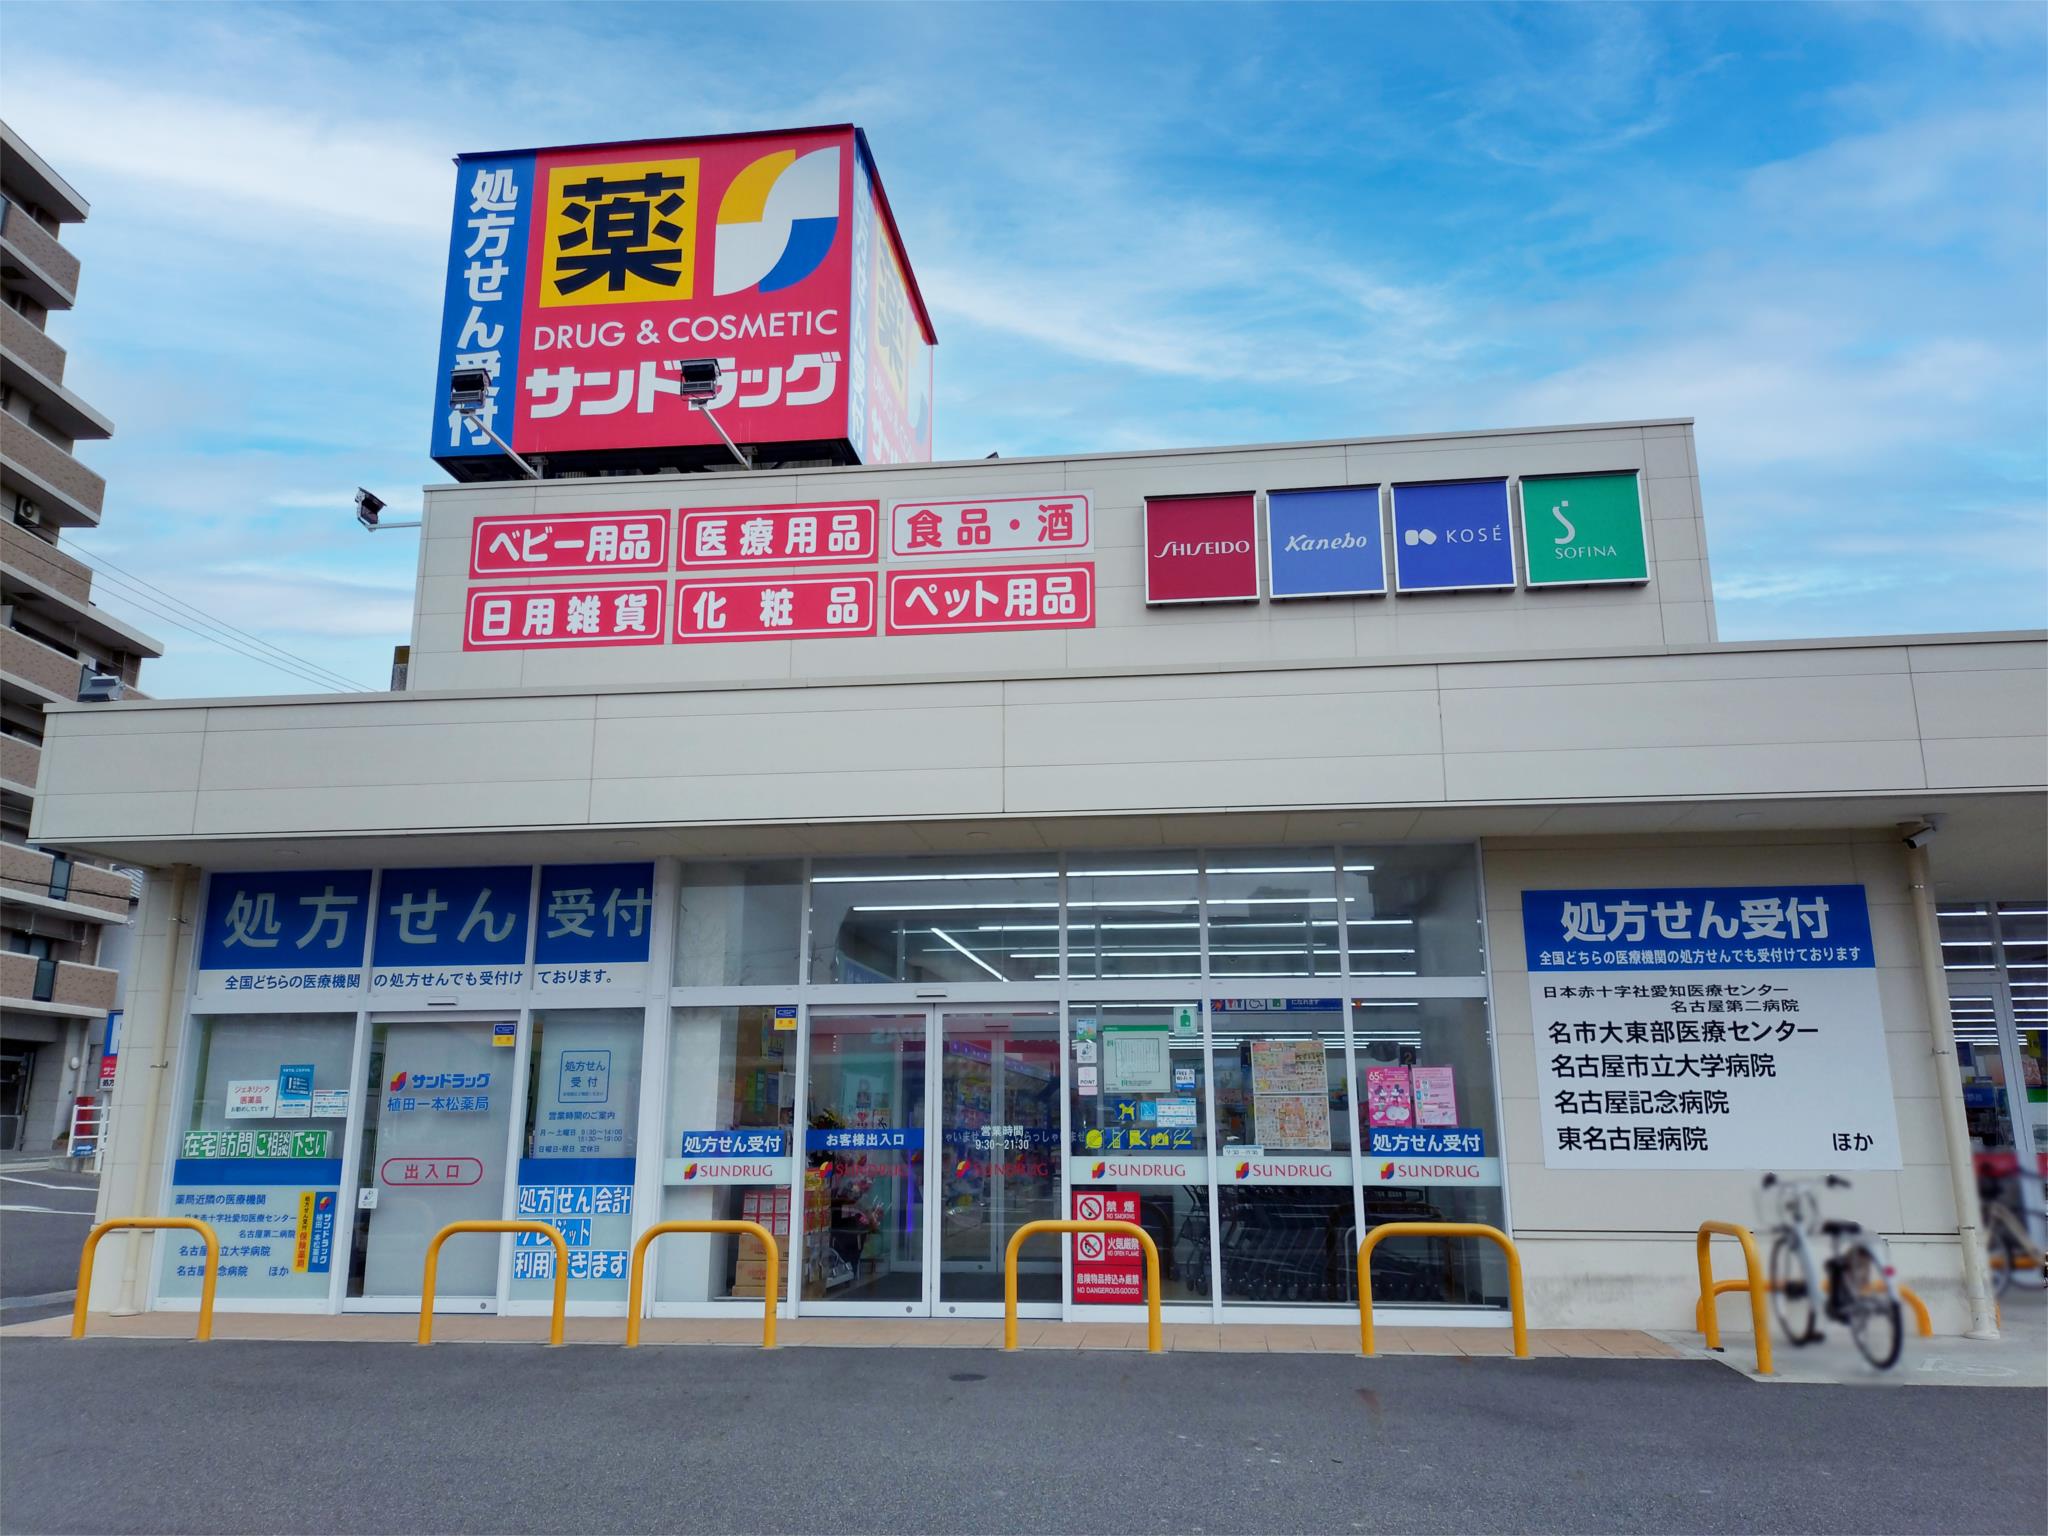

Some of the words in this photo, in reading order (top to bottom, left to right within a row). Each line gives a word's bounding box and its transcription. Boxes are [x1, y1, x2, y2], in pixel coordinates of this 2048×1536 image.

[554, 172, 685, 296] 薬
[534, 322, 625, 350] DRUG
[636, 319, 660, 344] &
[668, 310, 837, 343] COSMETIC
[696, 514, 861, 557] 医療用品
[1284, 532, 1367, 552] Kanebo
[1447, 524, 1502, 543] KOSÉ
[489, 524, 651, 563] ベビー用品
[1154, 540, 1250, 559] SHISEIDO
[1555, 546, 1617, 560] SOFINA
[905, 576, 1076, 619] ペット用品
[482, 594, 648, 637] 日用雑貨
[692, 585, 859, 632] 化粧品
[1560, 897, 1829, 942] 処方せん受付
[1539, 946, 1861, 966] 全国どちらの医療機関の処方せんでも受付けております
[1544, 984, 1789, 998] 日本赤十字社愛知医療センター
[1671, 1000, 1800, 1013] 名古屋第二病院
[1548, 1020, 1819, 1044] 名市大東部医療センター
[565, 1060, 605, 1072] 処方せん
[1551, 1053, 1776, 1078] 名古屋市立大学病院
[412, 1073, 490, 1088] サンドラッグ
[571, 1077, 598, 1087] 受付
[387, 1096, 489, 1112] 植田一本松薬局
[1554, 1090, 1730, 1115] 名古屋記念病院
[548, 1111, 615, 1121] 営業時間のご案内
[981, 1125, 1024, 1137] 営業時間
[1557, 1127, 1708, 1152] 東名古屋病院
[1832, 1132, 1873, 1152] ほか
[184, 1132, 326, 1157] 在宅訪問ご相談下さい
[684, 1136, 781, 1153] 処方せん受付
[826, 1134, 905, 1147] お客様出入口
[1373, 1134, 1480, 1152] 処方せん受付
[405, 1164, 460, 1179] 出入口
[700, 1165, 773, 1177] SUNDRUG
[1109, 1164, 1186, 1177] SUNDRUG
[1254, 1165, 1331, 1177] SUNDRUG
[1398, 1165, 1479, 1177] SUNDRUG
[520, 1187, 630, 1213] 処方せん会計
[179, 1246, 271, 1256] 名古屋立大学病院
[177, 1266, 248, 1277] 名古屋念病院
[269, 1266, 289, 1276] ほか
[515, 1252, 626, 1278] 利用きます
